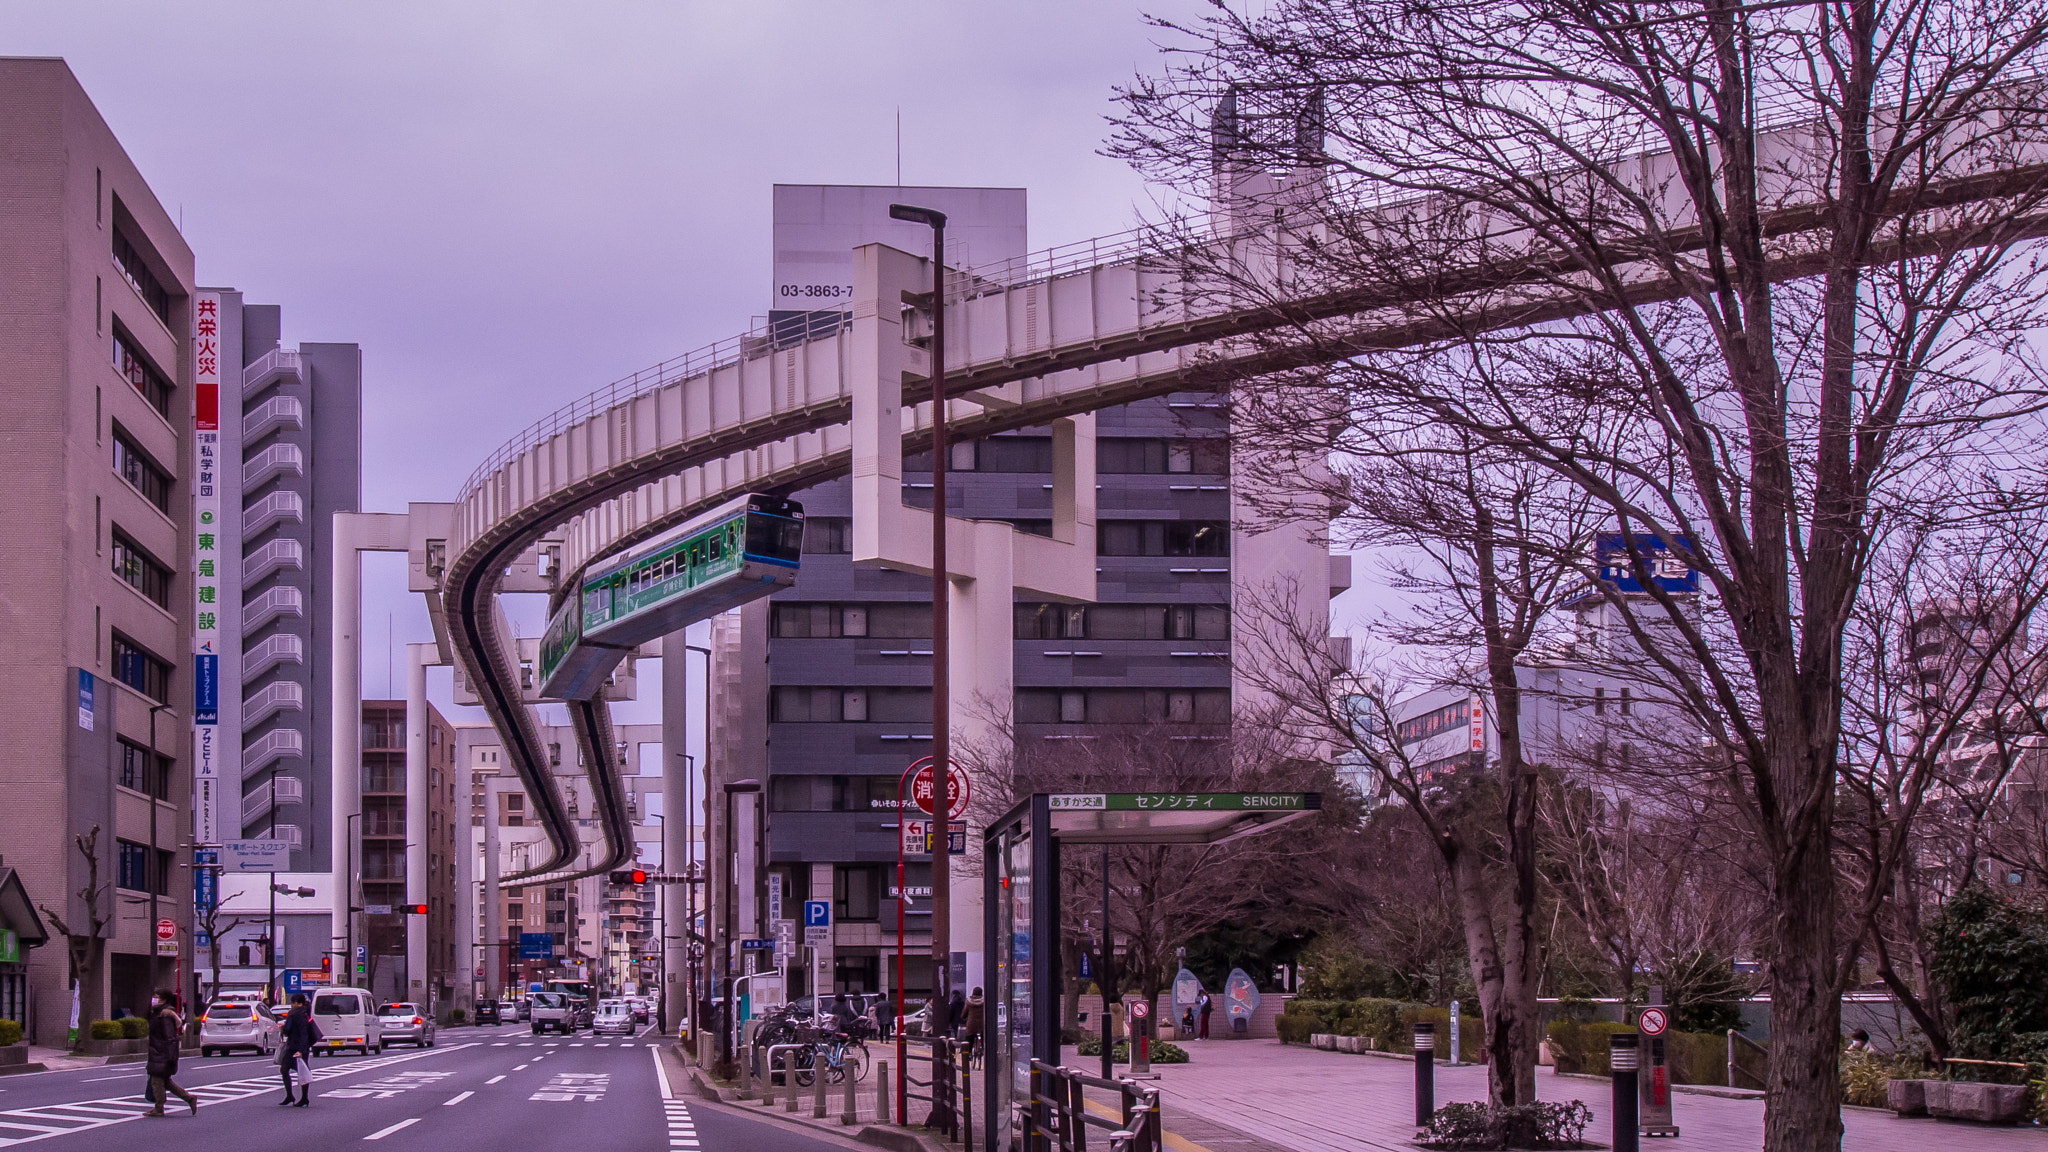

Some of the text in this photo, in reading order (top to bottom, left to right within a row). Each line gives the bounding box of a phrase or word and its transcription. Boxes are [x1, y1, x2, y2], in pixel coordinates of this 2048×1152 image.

[781, 284, 853, 297] 03-3863-7
[198, 299, 216, 376] 共栄火災
[200, 445, 213, 496] 私学財団
[198, 532, 216, 630] 東急建設
[1472, 708, 1482, 748] 第一学院
[202, 728, 211, 774] アサヒビール
[916, 780, 957, 800] 消栓
[1051, 797, 1103, 807] あすか交通
[1136, 795, 1299, 808] センシティ SENCITY
[906, 844, 923, 852] 左折
[891, 887, 930, 895] 和皮膚科
[811, 903, 825, 924] P
